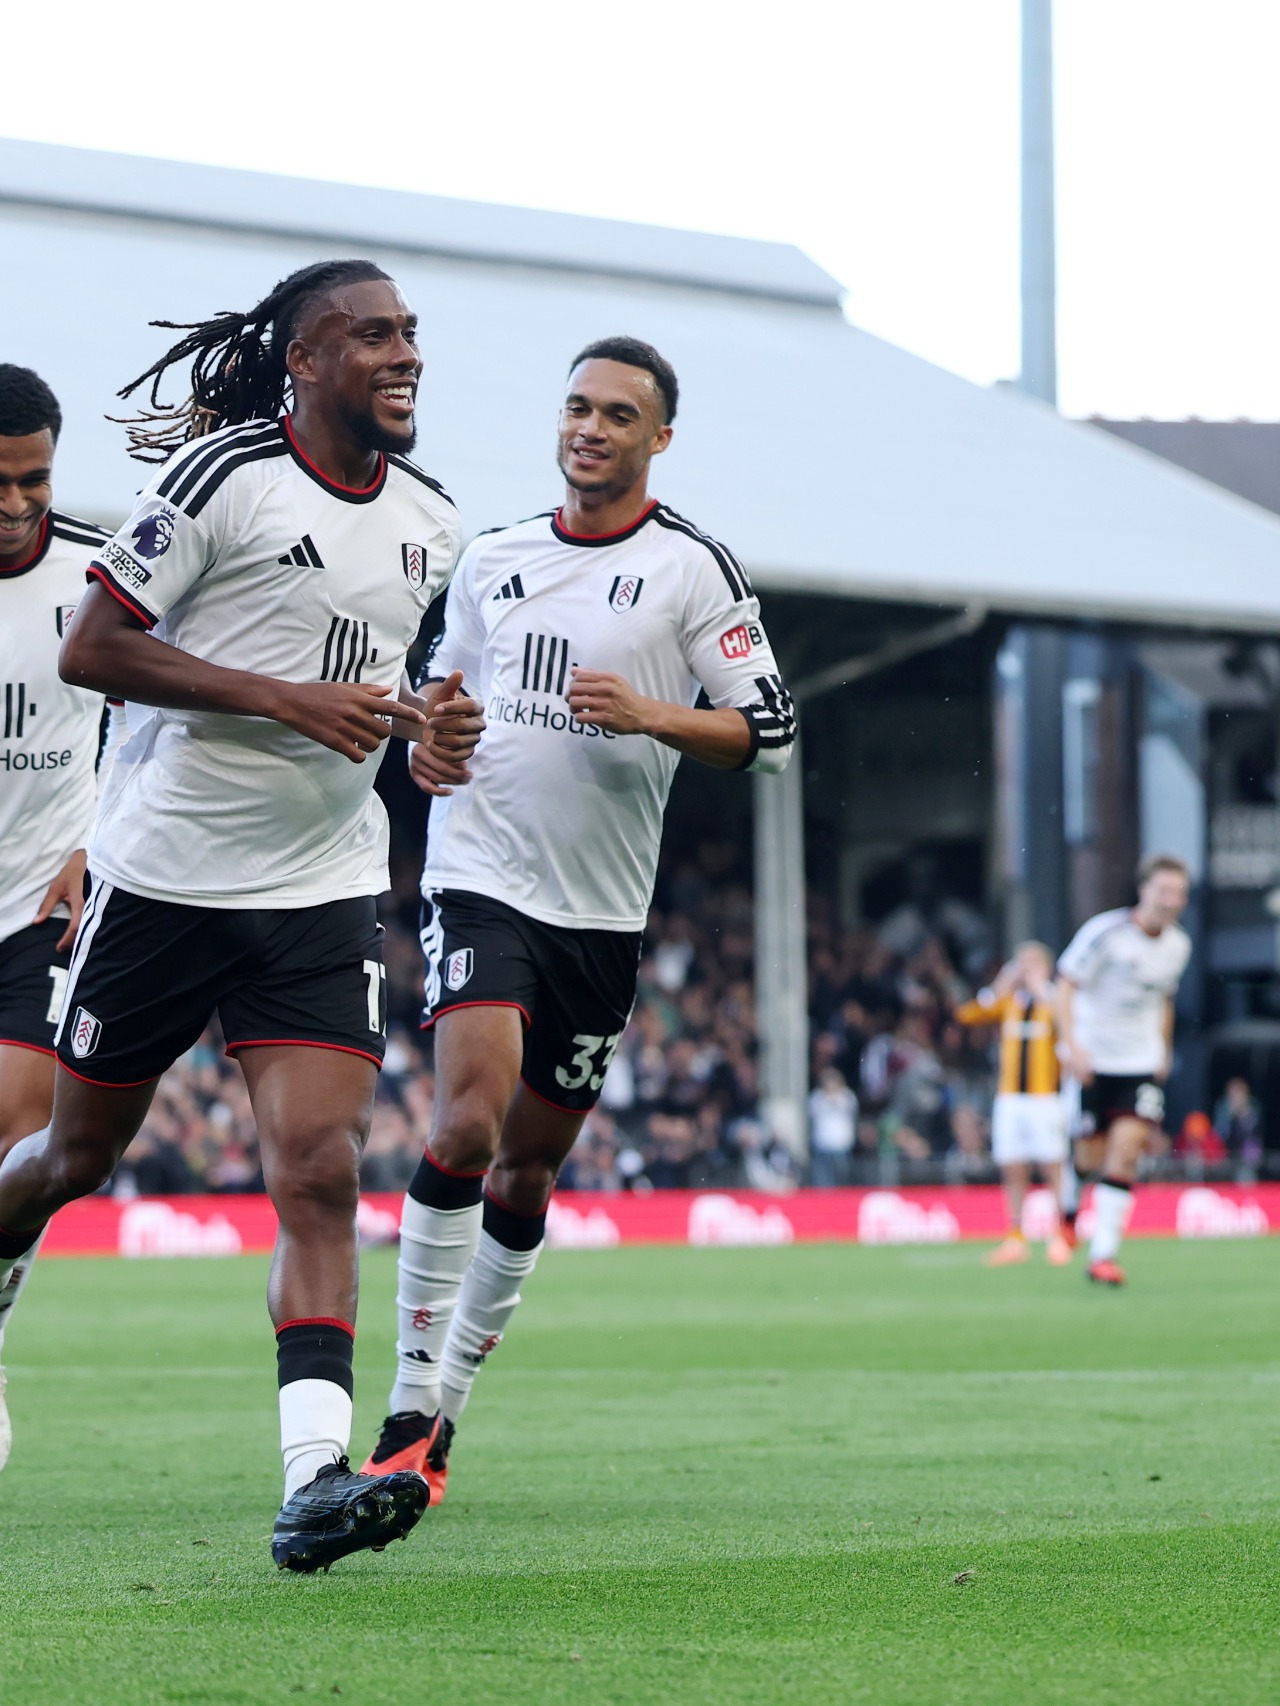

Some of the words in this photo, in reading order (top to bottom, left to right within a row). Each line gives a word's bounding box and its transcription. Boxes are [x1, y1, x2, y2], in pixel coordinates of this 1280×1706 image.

[100, 550, 117, 563] for
[113, 560, 144, 591] racism
[106, 542, 123, 557] No
[121, 555, 146, 580] room
[363, 959, 386, 1033] 1
